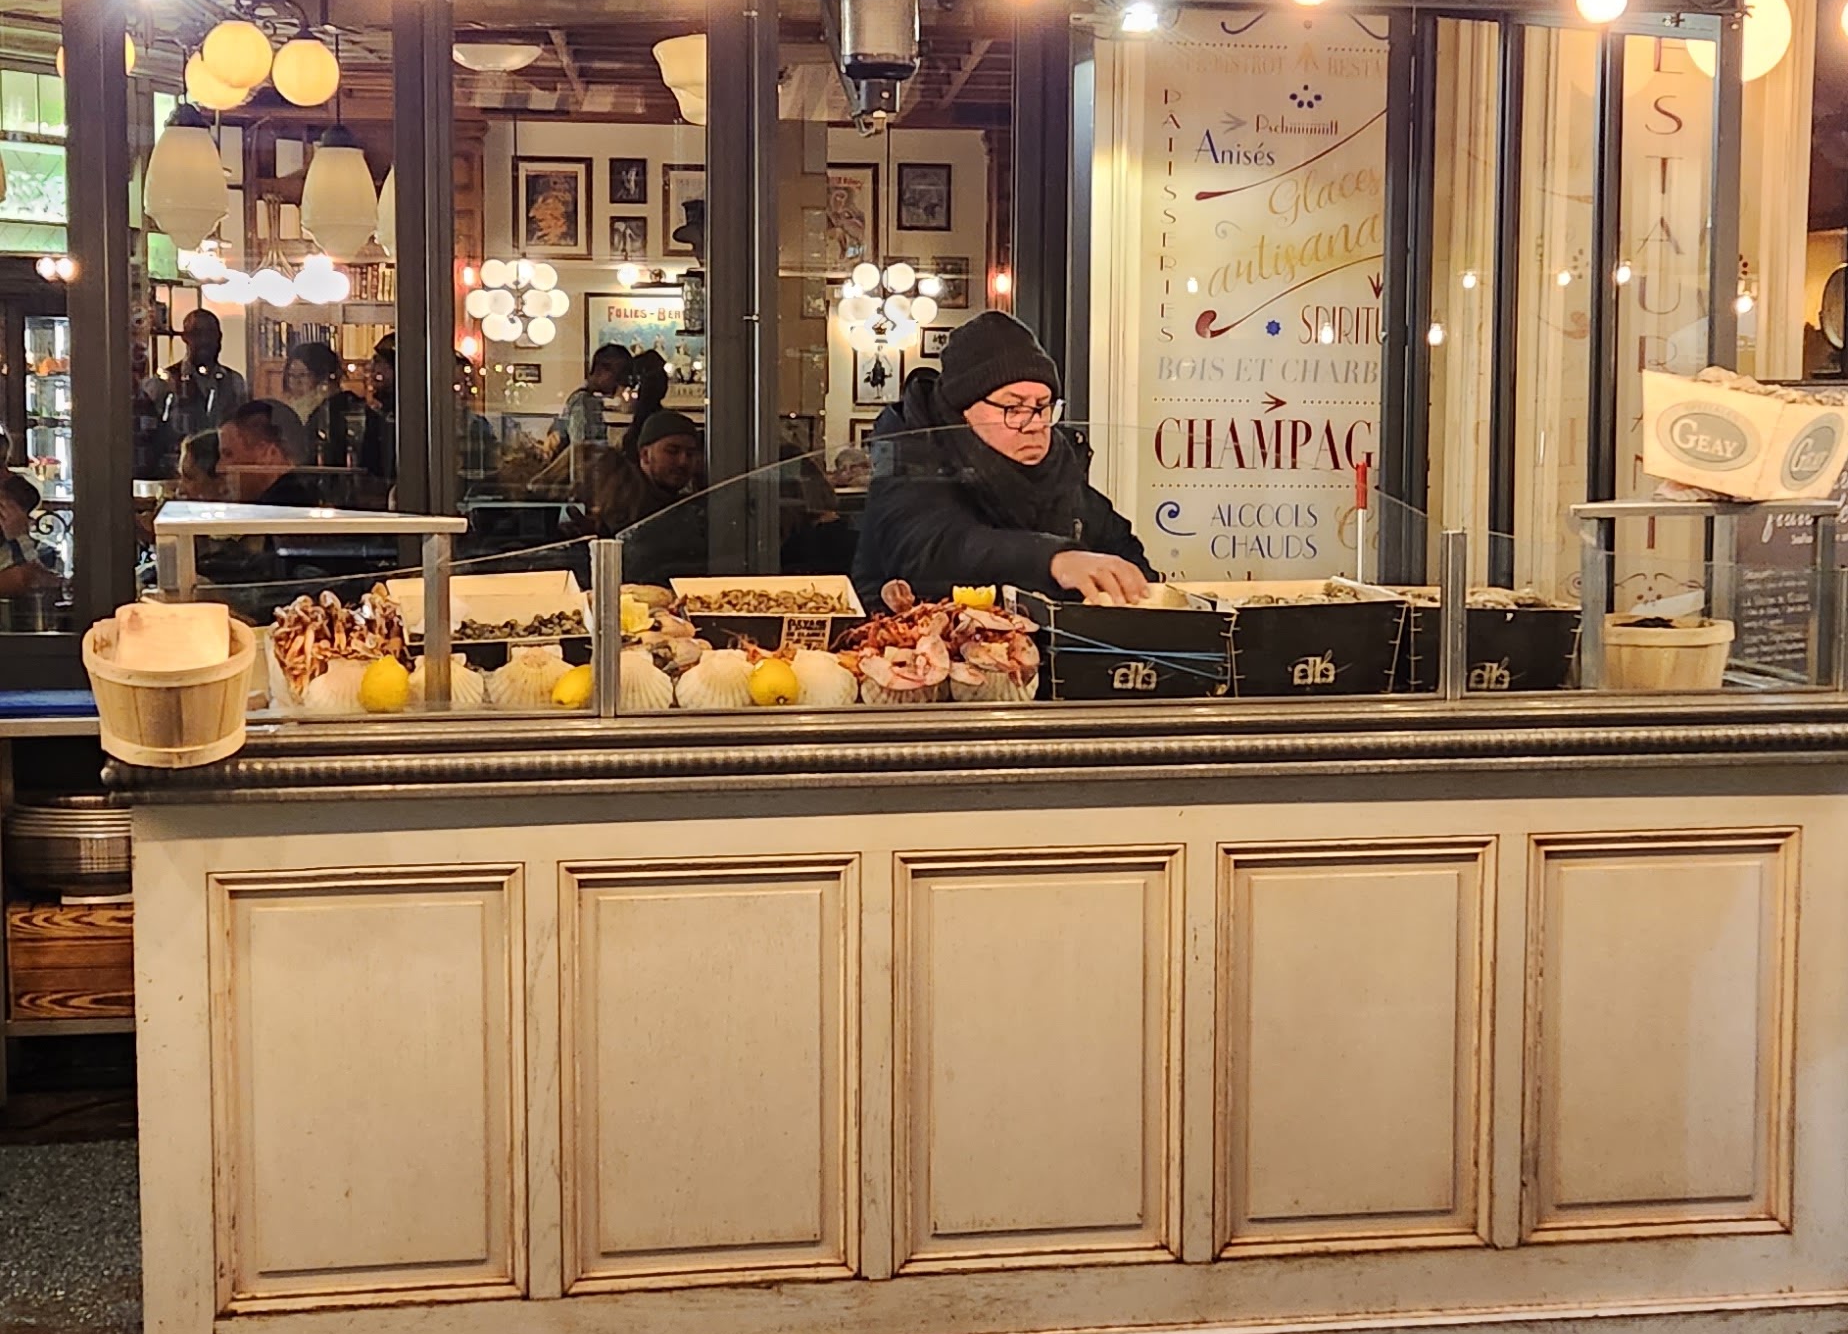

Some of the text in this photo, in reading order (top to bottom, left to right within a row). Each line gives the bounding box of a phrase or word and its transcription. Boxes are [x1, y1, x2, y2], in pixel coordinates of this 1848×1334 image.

[1195, 128, 1276, 167] Anisés
[1268, 167, 1382, 227] Glaces
[1157, 355, 1378, 385] BOIS ET CHARB
[1154, 417, 1381, 471] CHAMPAG
[1210, 502, 1319, 529] ALCOOLS
[1210, 534, 1319, 561] CHAUDS
